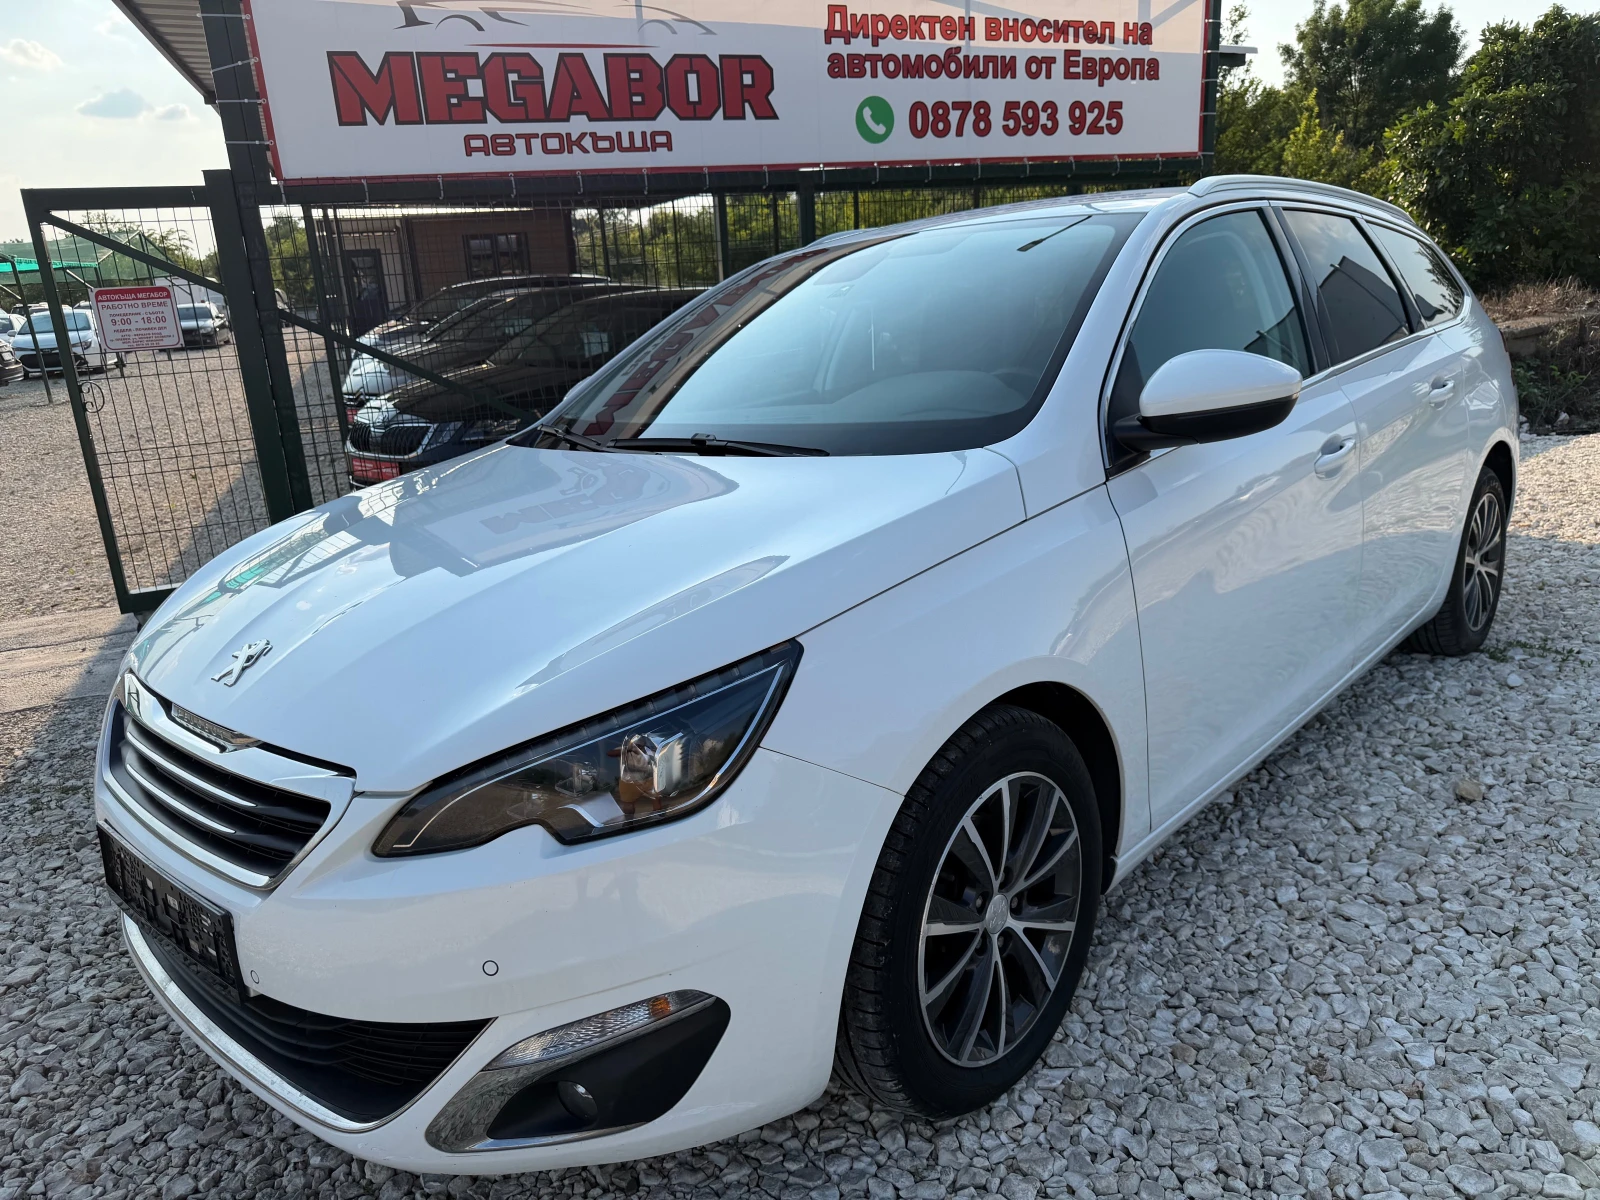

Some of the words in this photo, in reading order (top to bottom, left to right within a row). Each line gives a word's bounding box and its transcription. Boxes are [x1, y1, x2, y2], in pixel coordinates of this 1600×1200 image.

[824, 4, 976, 47] Директен
[985, 19, 1115, 44] вносител
[1123, 21, 1153, 45] на
[827, 46, 1017, 80] автомобили
[1025, 55, 1056, 80] от
[1063, 49, 1160, 87] Европа
[326, 50, 779, 127] MEGABOR
[908, 100, 992, 139] 0878
[1001, 100, 1059, 137] 593
[1068, 100, 1124, 136] 925
[463, 130, 673, 157] АВТОКЪЩА
[97, 293, 137, 301] АВТОКЪЩА
[138, 291, 168, 299] МЕГАБОР
[101, 302, 139, 310] РАБОТНО
[141, 301, 168, 309] ВРЕМЕ
[111, 317, 132, 326] 9:00
[141, 316, 167, 325] 18:00
